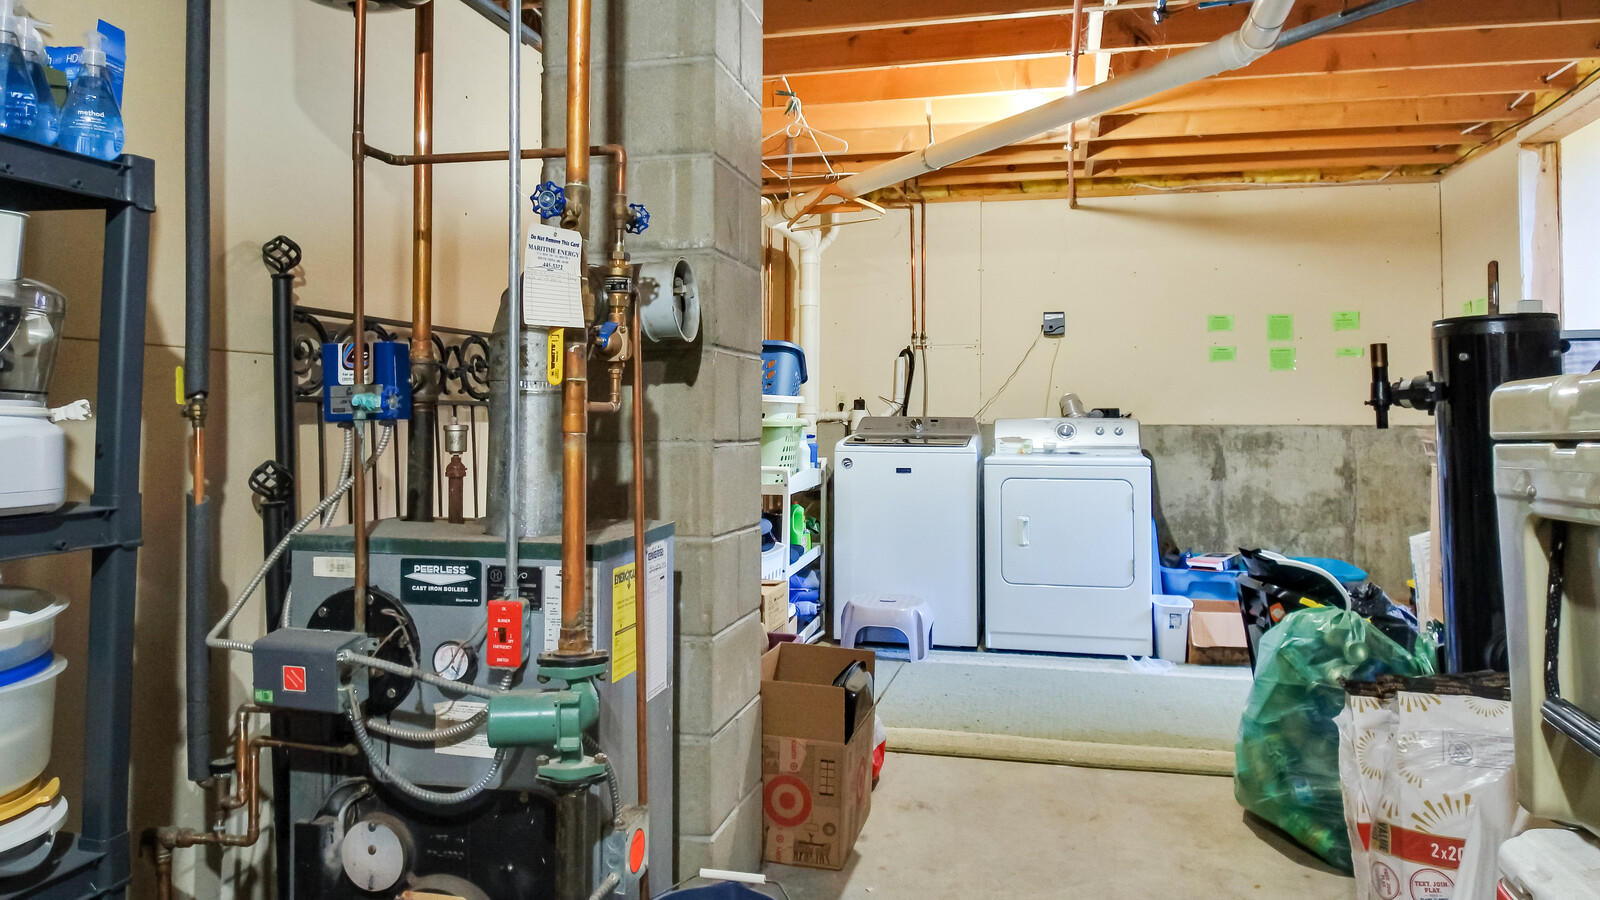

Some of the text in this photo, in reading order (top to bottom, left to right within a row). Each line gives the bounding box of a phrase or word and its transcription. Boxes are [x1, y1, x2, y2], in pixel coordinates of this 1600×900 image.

[78, 109, 104, 118] method
[528, 244, 556, 253] MARITIME
[558, 249, 579, 258] ENERGY
[414, 565, 466, 574] PEERLESS
